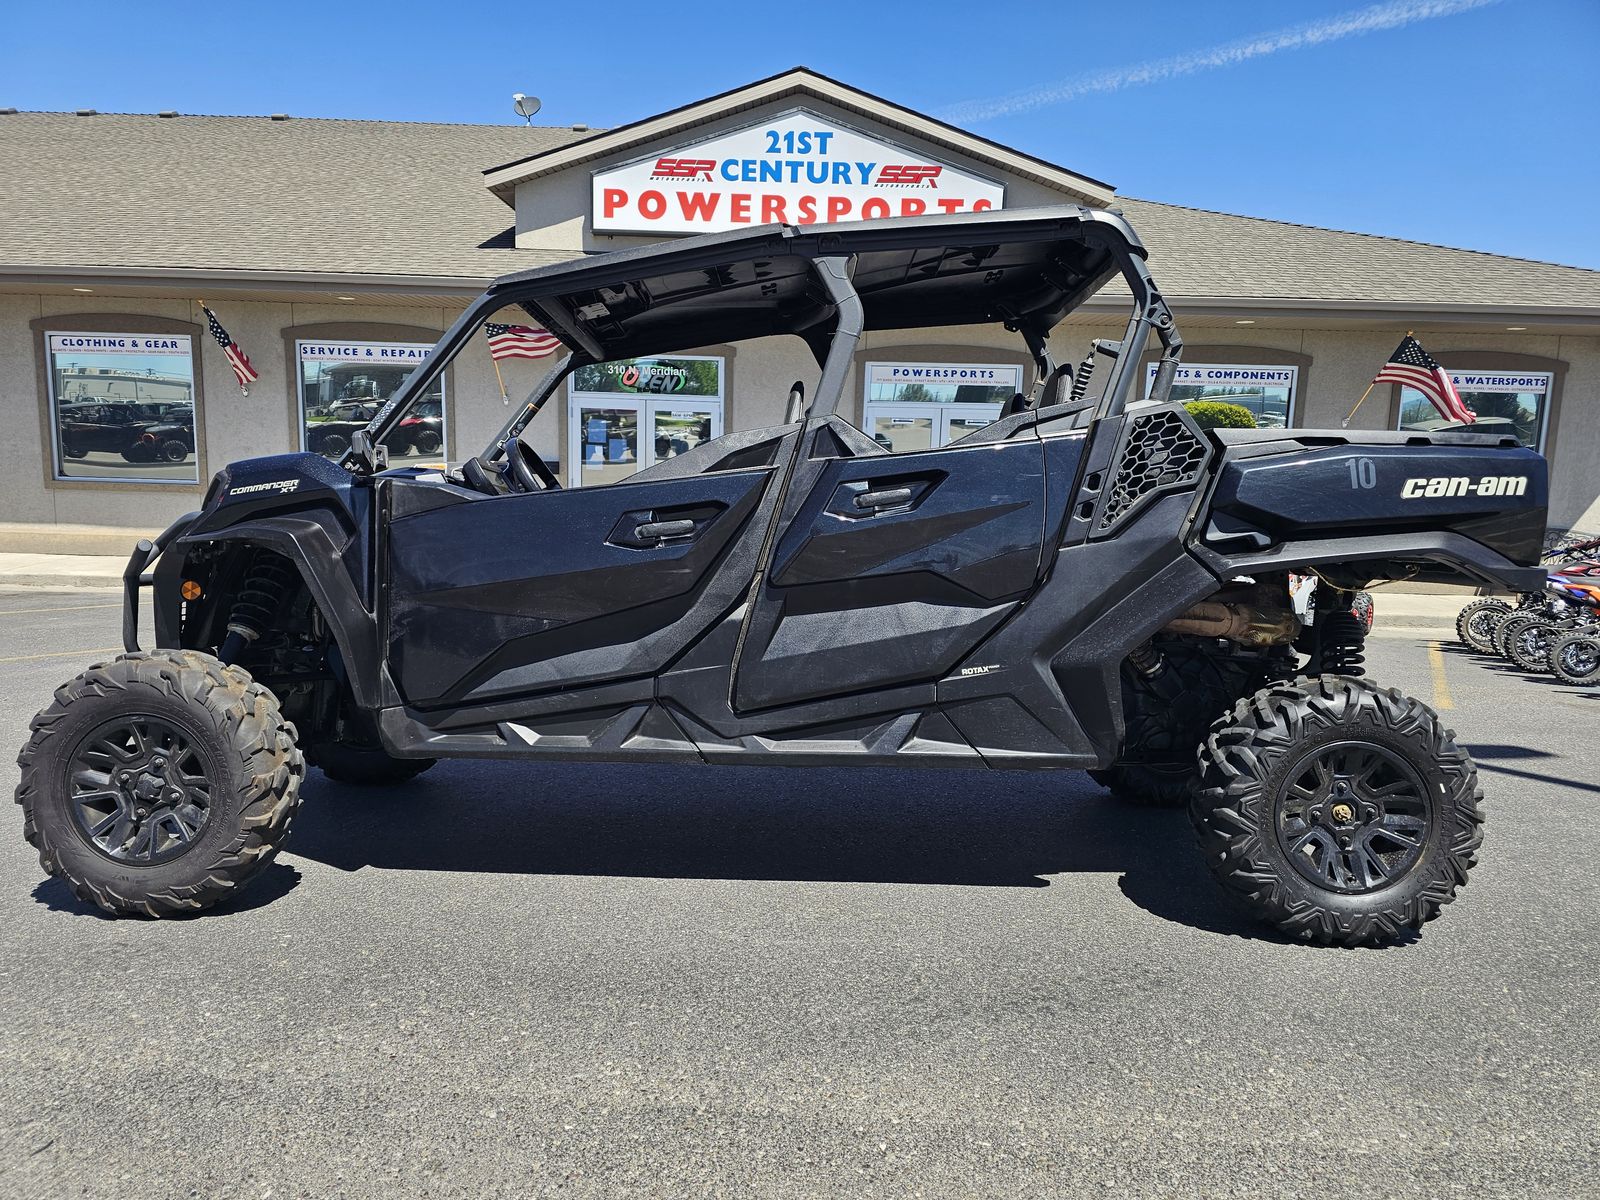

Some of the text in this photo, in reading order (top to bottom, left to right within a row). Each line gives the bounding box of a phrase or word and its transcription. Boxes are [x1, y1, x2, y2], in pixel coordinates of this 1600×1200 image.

[766, 130, 834, 155] 21ST
[652, 158, 717, 182] SSR
[720, 159, 877, 185] CENTURY
[876, 165, 943, 189] SSR
[61, 338, 179, 349] CLOTHING & GEAR
[302, 346, 359, 356] SERVICE
[365, 348, 373, 357] &
[607, 365, 626, 375] 310
[642, 366, 686, 376] Meridian
[893, 368, 995, 379] POWERSPORTS
[1150, 369, 1290, 381] PTS & COMPONENTS
[622, 368, 679, 393] OPEN
[1452, 376, 1547, 387] & WATERSPORTS
[1345, 457, 1377, 490] 10
[229, 479, 300, 495] COMMANDER
[279, 486, 298, 494] XT
[1401, 476, 1528, 499] can-am
[961, 665, 989, 675] ROTAX
